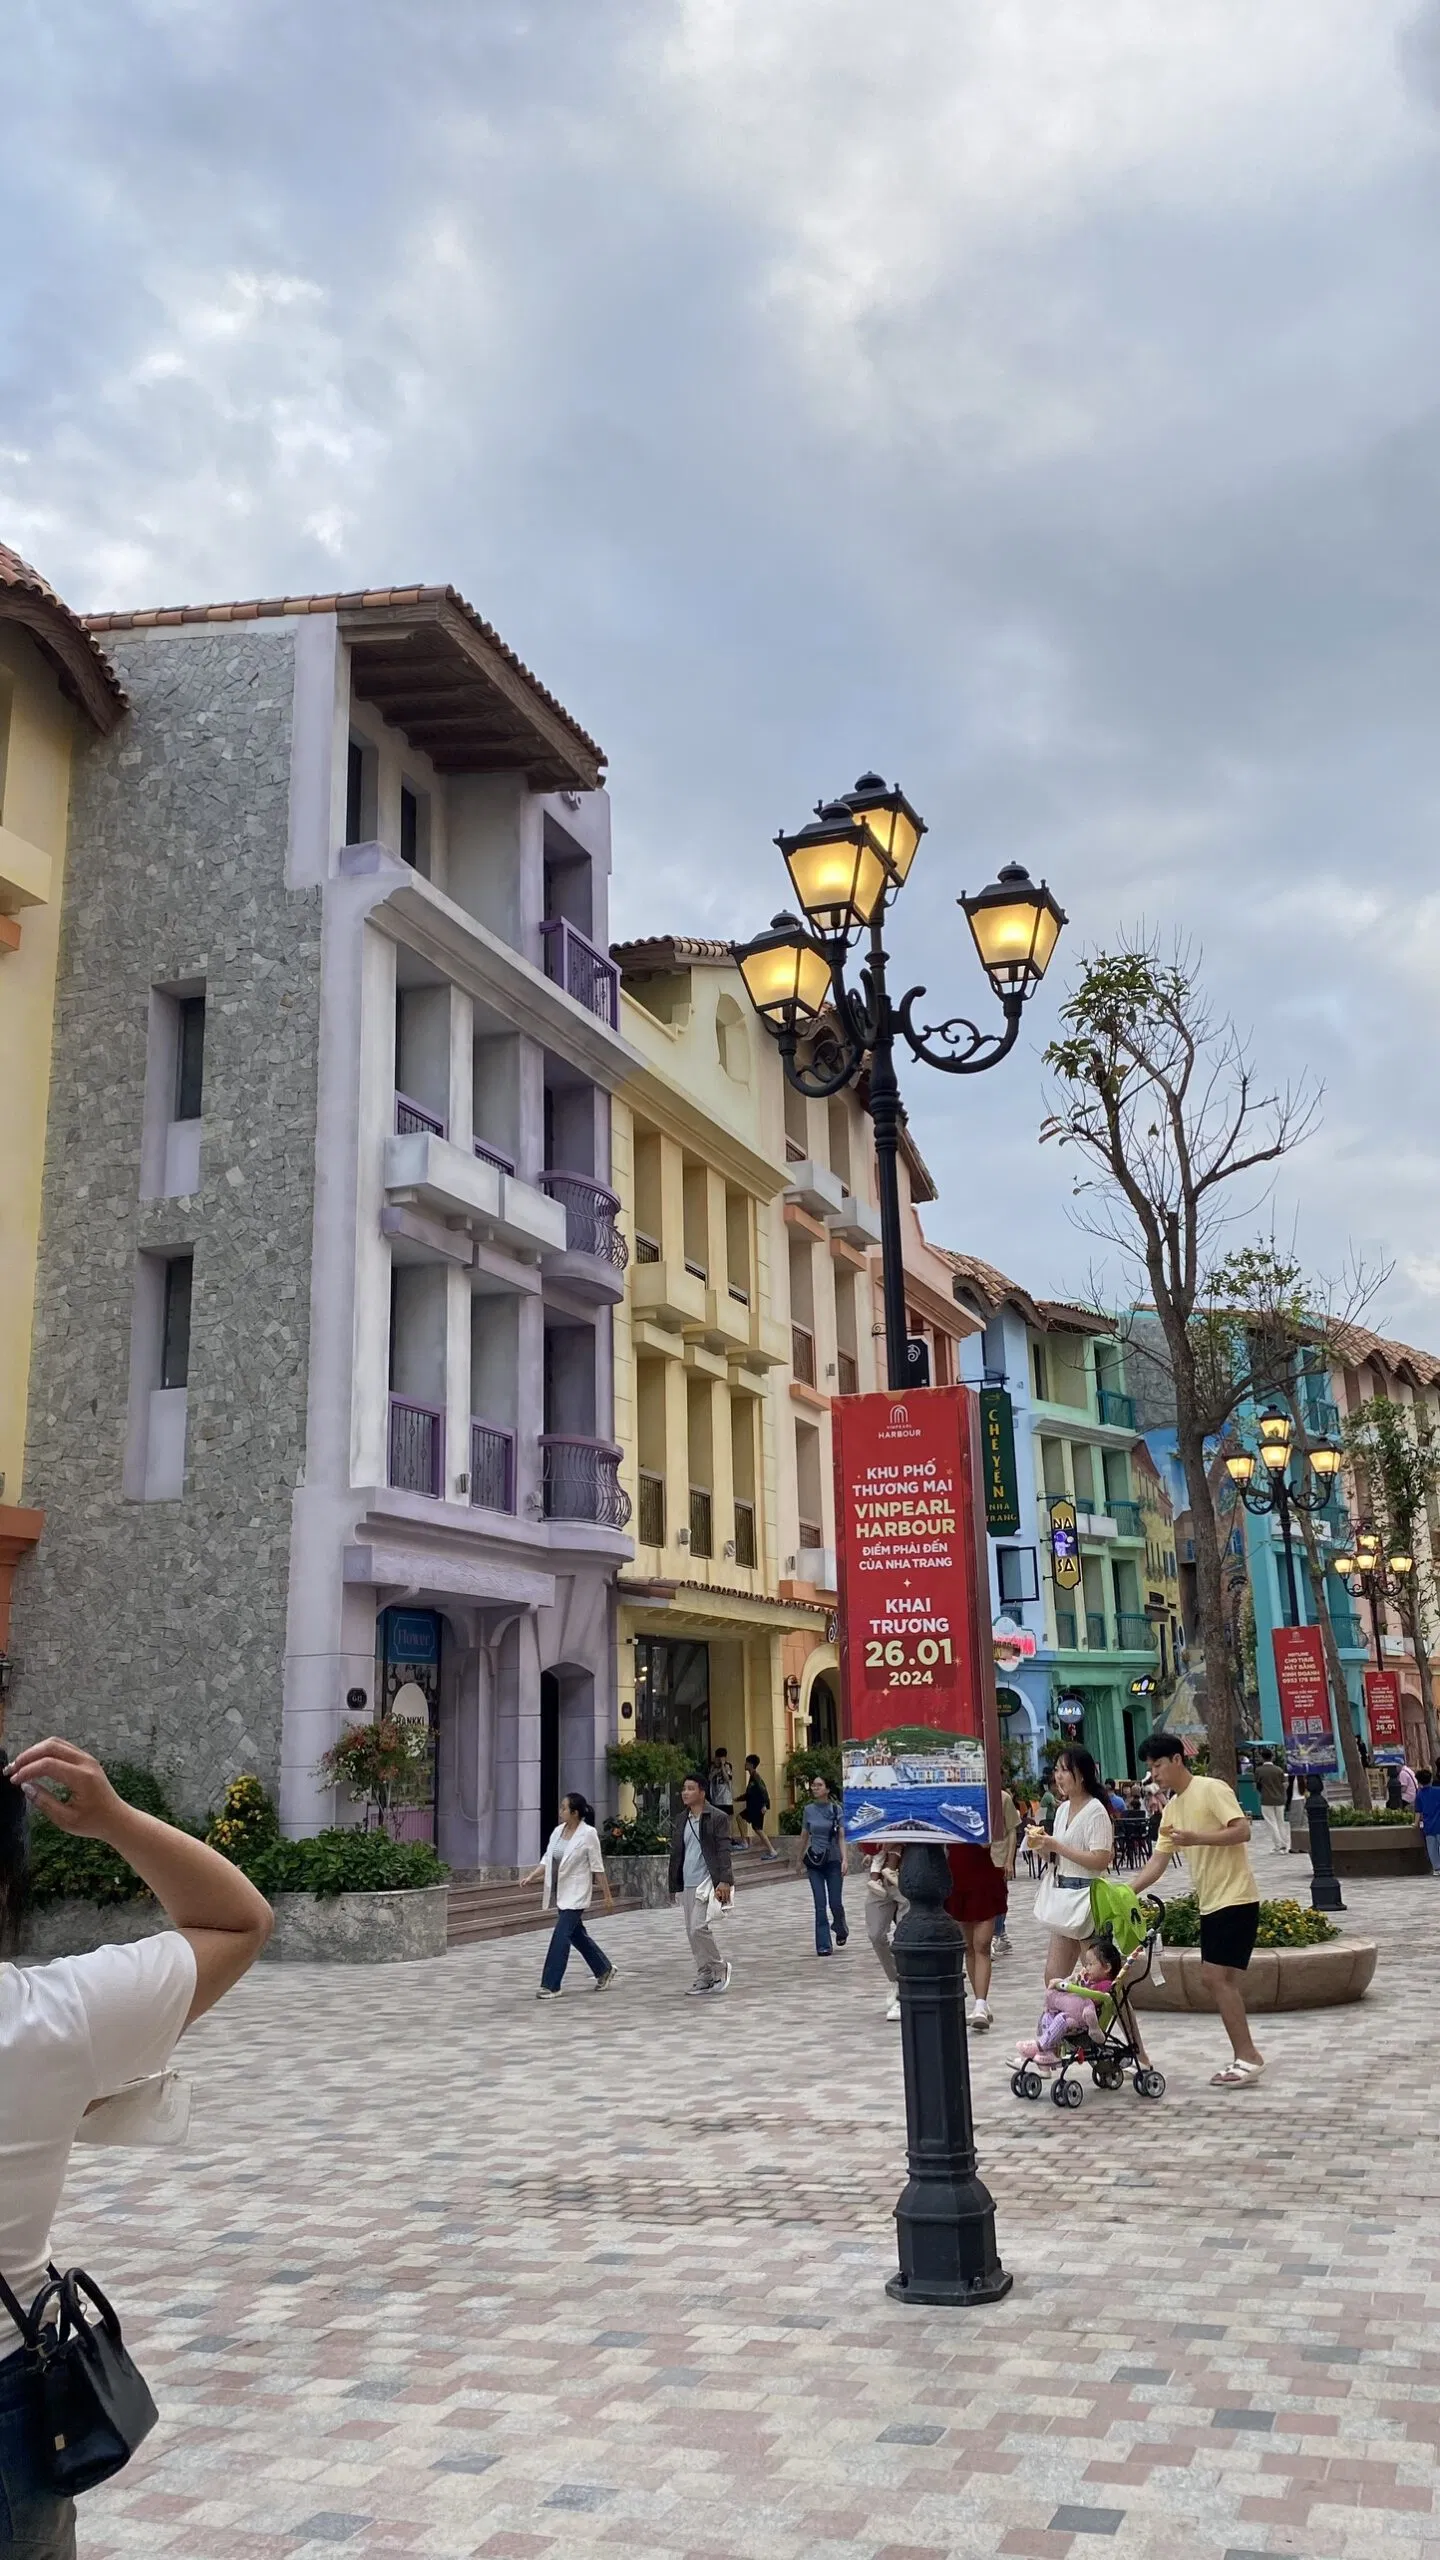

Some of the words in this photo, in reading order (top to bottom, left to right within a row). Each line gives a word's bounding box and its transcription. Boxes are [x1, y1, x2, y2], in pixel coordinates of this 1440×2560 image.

[878, 1429, 921, 1439] HARBOUR
[866, 1466, 899, 1480] KHU
[903, 1457, 937, 1477] PHỐ
[852, 1482, 919, 1497] THƯƠNG
[923, 1479, 953, 1495] MẠI
[854, 1498, 956, 1519] VINPEARL
[856, 1518, 956, 1539] HARBOUR
[862, 1541, 891, 1556] ĐIỂM
[892, 1541, 920, 1554] PHẢI
[922, 1539, 948, 1553] ĐẾN
[859, 1558, 884, 1571] CỦA
[885, 1559, 911, 1570] NHA
[911, 1557, 952, 1568] TRANG
[885, 1597, 931, 1613] KHAI
[869, 1617, 950, 1634] TRƯƠNG
[865, 1638, 952, 1667] 26.01
[889, 1670, 933, 1686] 2024
